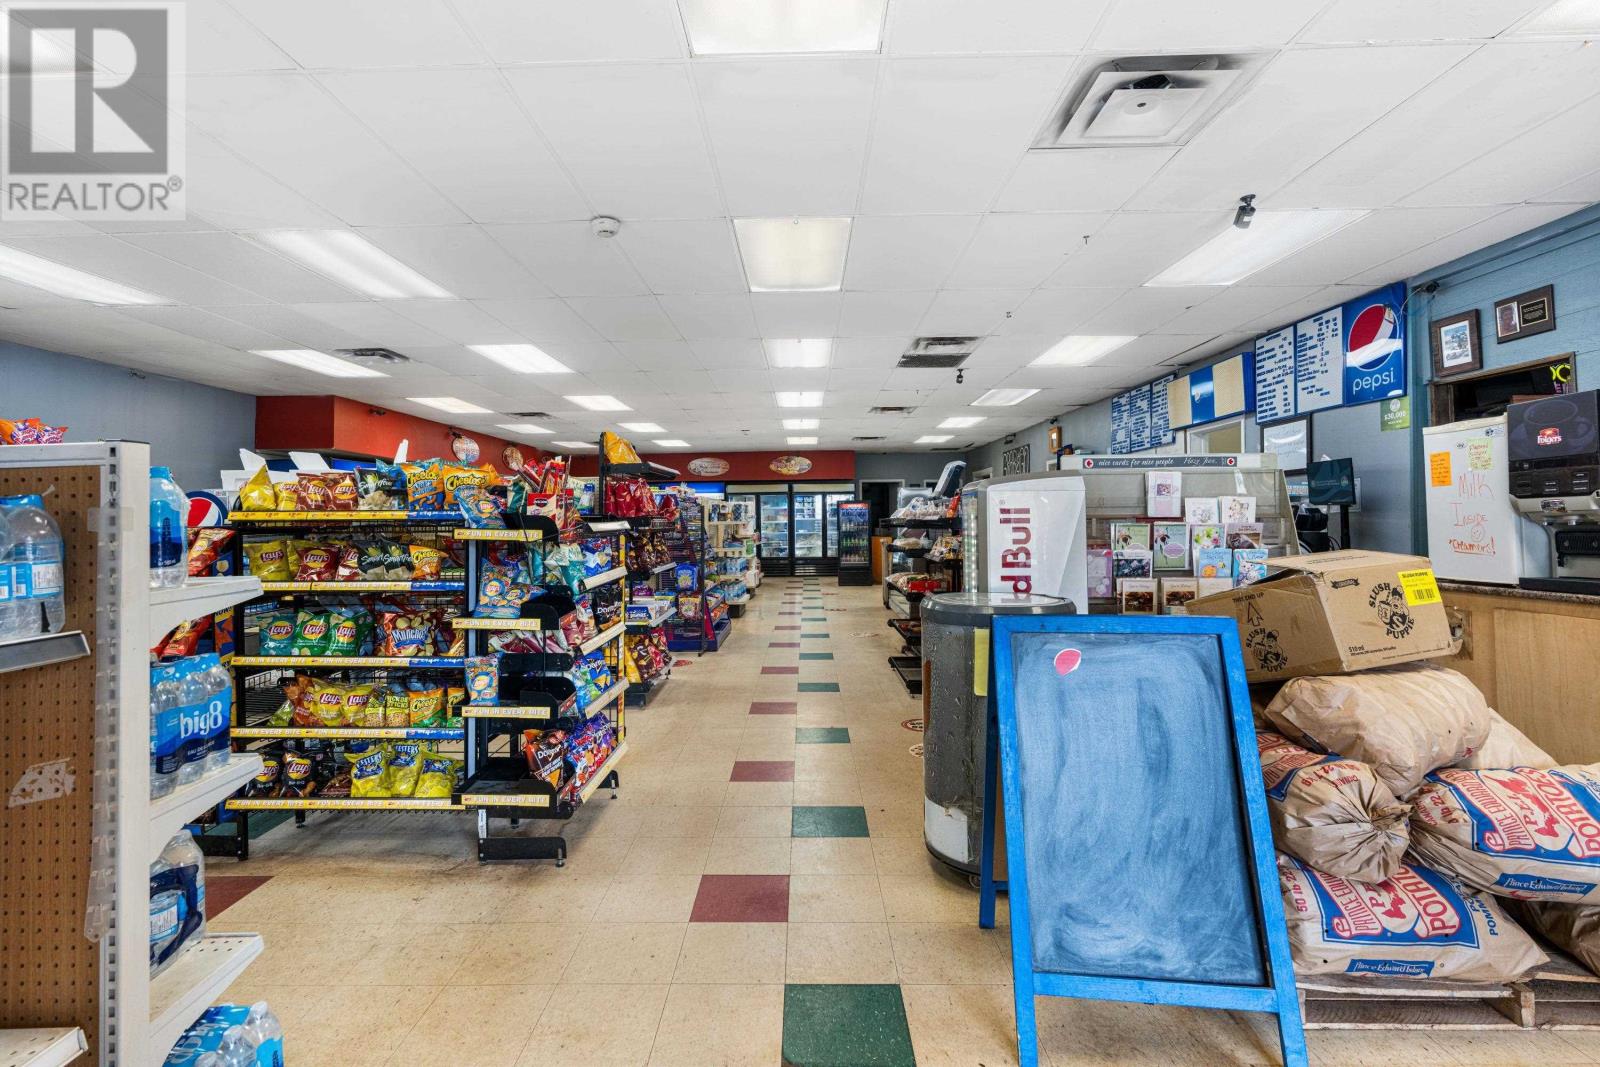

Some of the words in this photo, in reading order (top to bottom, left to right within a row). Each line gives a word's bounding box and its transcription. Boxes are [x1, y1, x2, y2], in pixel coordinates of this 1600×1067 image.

[1353, 368, 1394, 395] pepsi
[1537, 435, 1562, 445] Folgers
[446, 476, 487, 492] Cheetos
[1458, 472, 1494, 497] Milk
[1000, 508, 1032, 568] Bull
[306, 553, 329, 561] Lay's
[1368, 582, 1391, 608] SLUSH
[269, 624, 292, 634] Lay's
[303, 624, 325, 634] Lay's
[1246, 628, 1266, 648] SLUSH
[1386, 617, 1415, 639] PUPPIE
[180, 701, 223, 739] big8
[1496, 812, 1533, 847] PRINCE
[1295, 898, 1308, 912] 50
[1341, 895, 1379, 931] PRINCE
